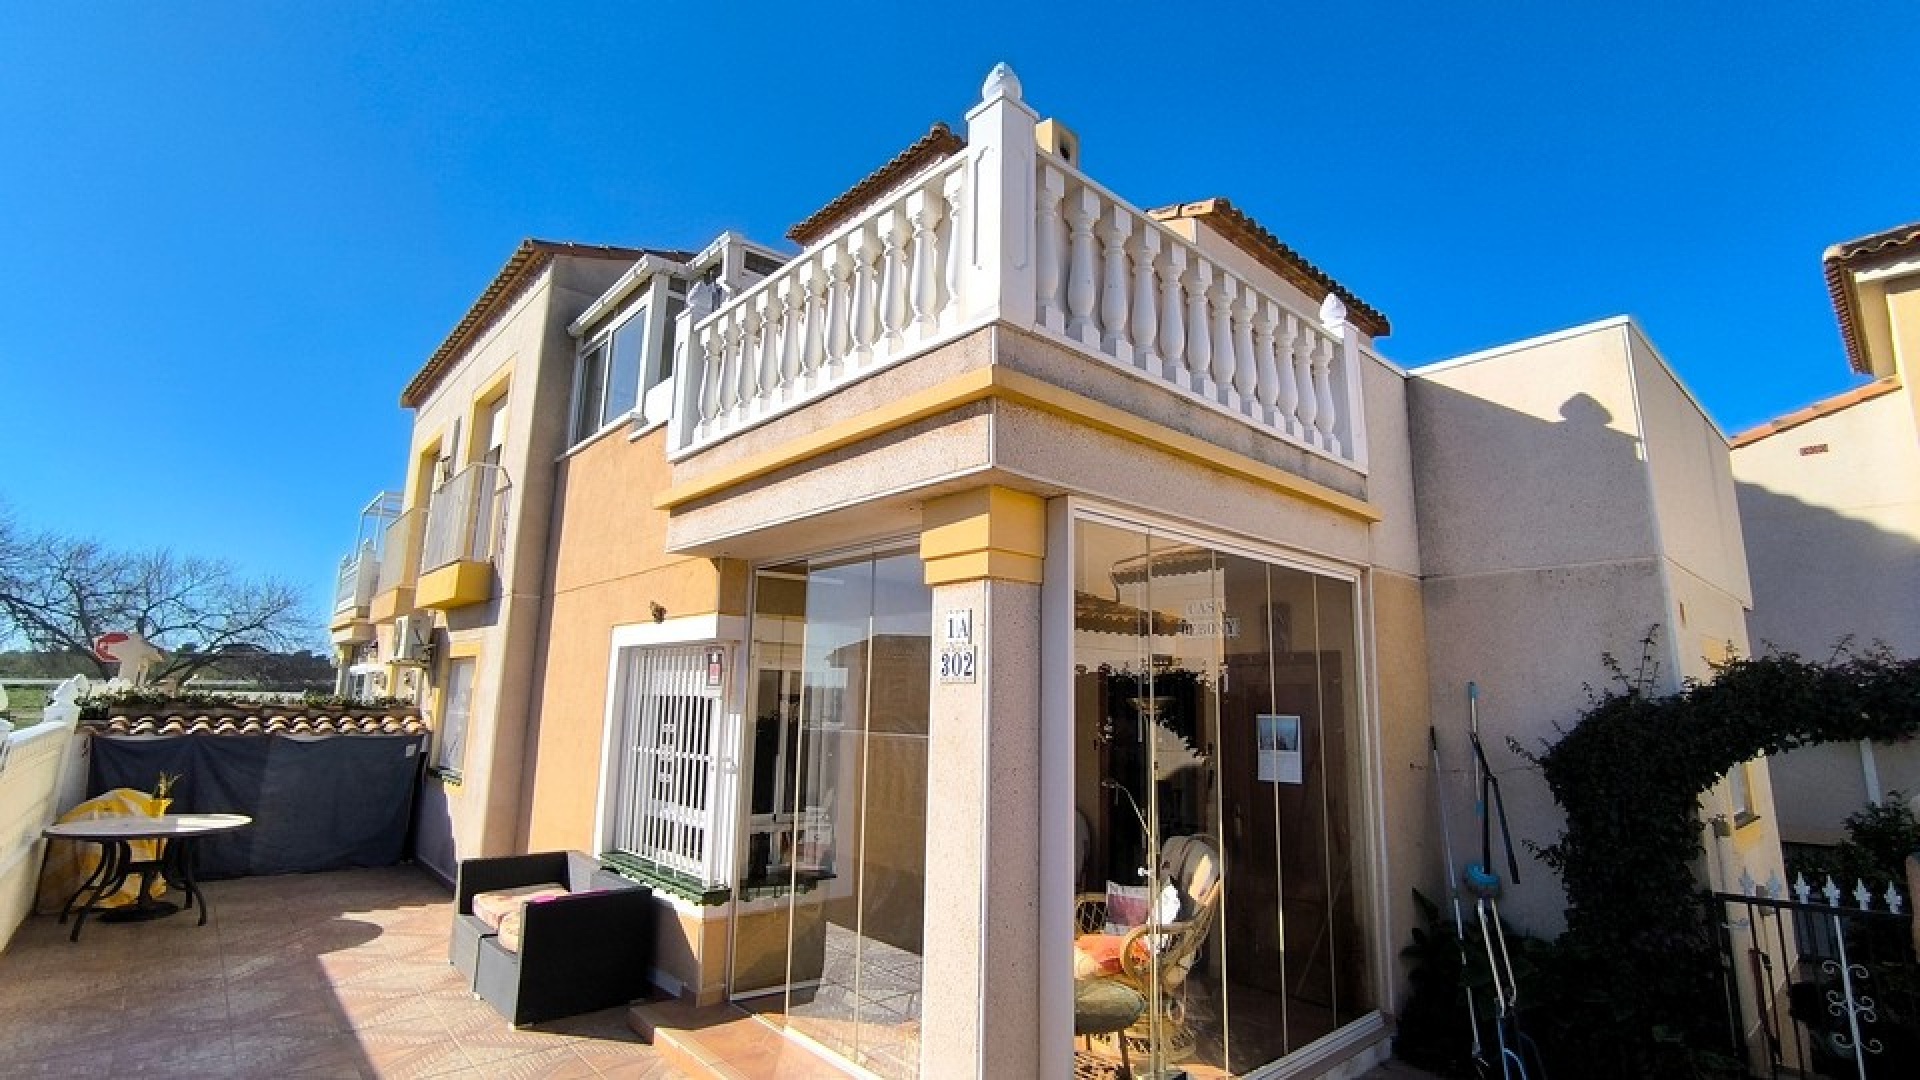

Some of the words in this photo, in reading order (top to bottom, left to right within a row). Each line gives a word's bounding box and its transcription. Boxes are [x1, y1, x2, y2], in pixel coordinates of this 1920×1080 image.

[1187, 601, 1225, 615] CASA
[948, 618, 969, 638] 1A
[941, 652, 972, 677] 302
